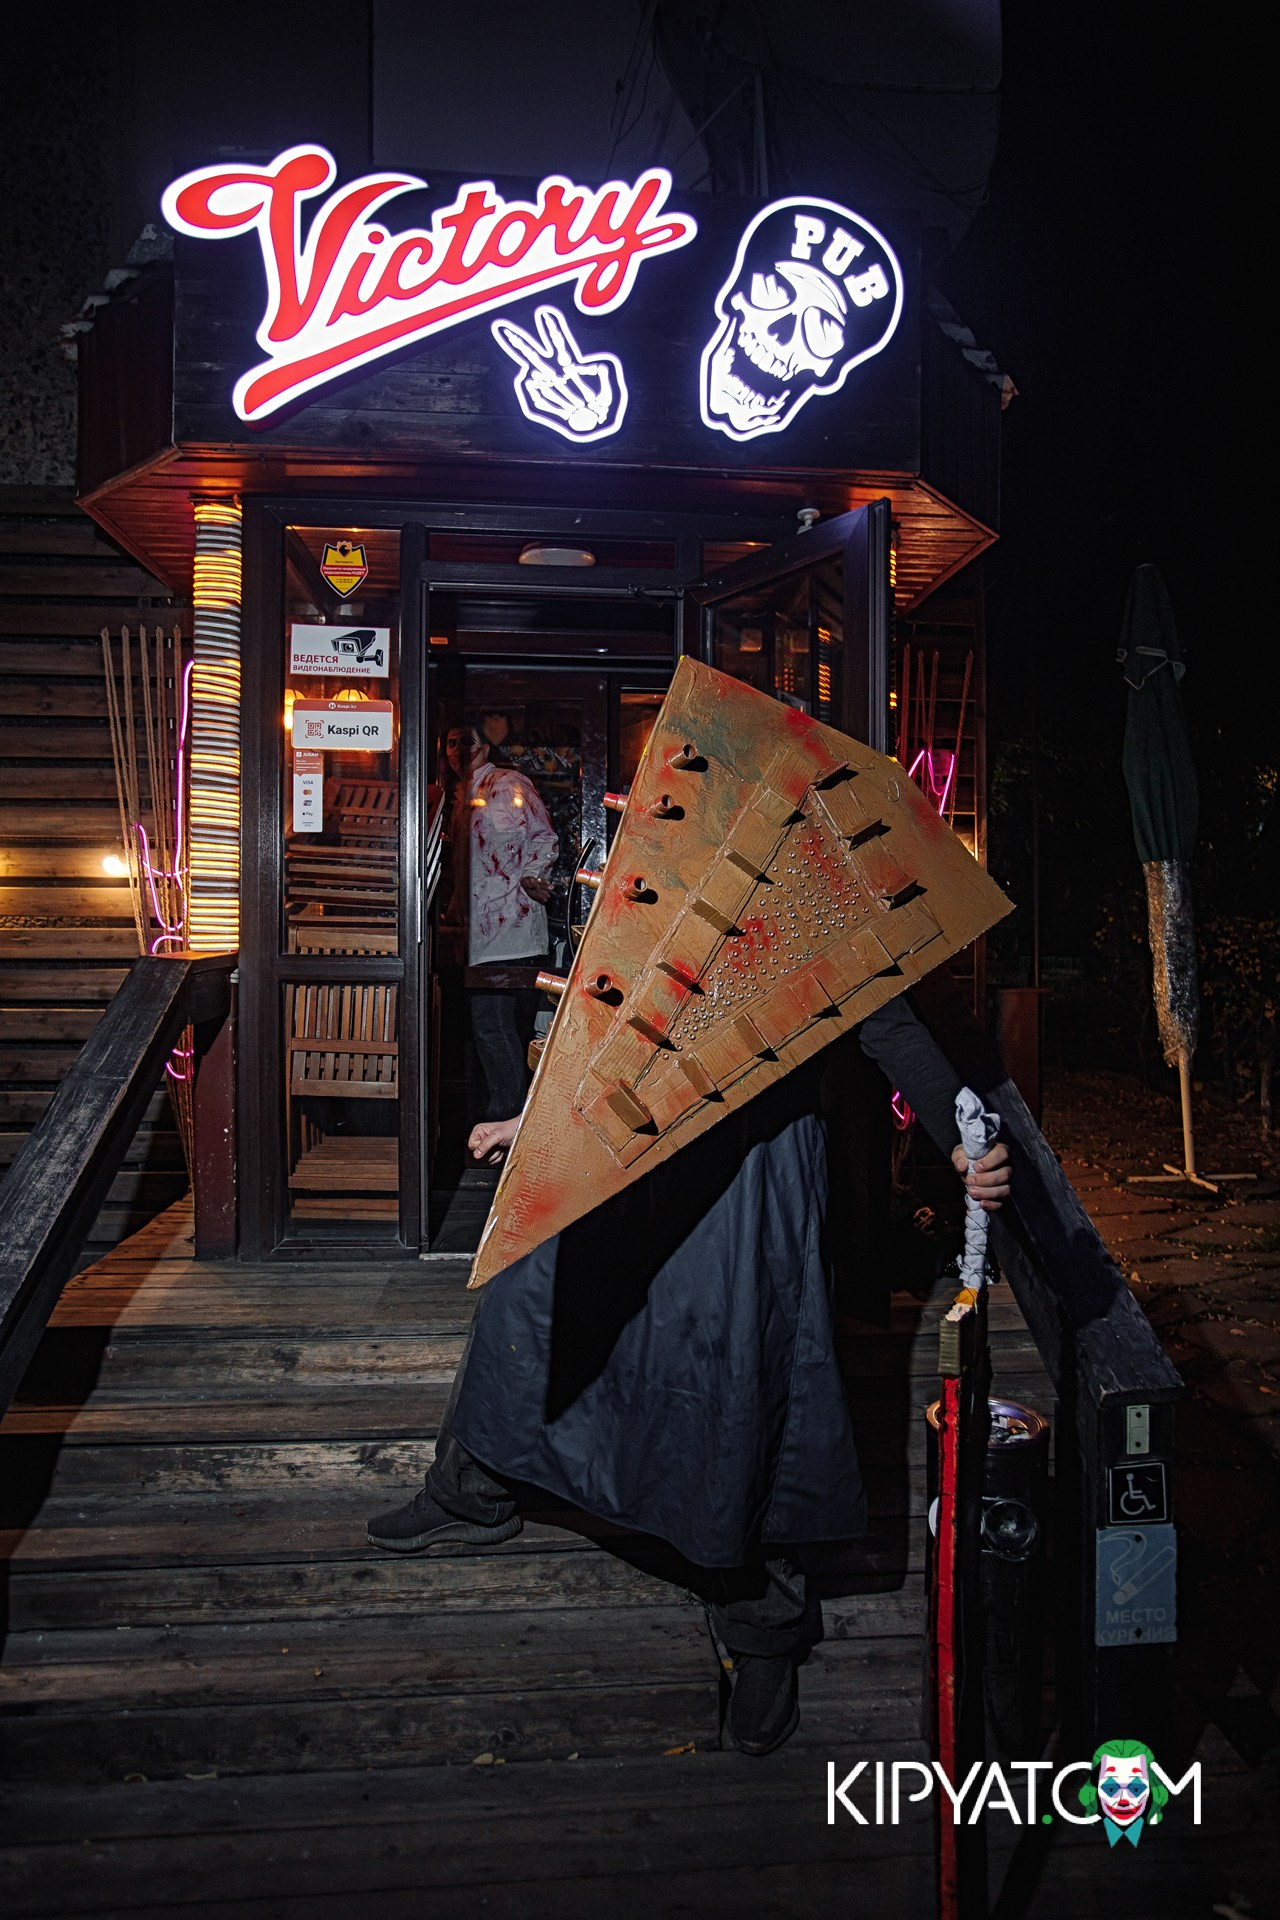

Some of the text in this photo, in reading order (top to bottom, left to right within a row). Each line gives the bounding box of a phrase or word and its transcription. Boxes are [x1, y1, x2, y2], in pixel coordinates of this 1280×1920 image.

[790, 213, 890, 308] PUB
[164, 145, 695, 417] Victory
[293, 653, 339, 664] ВЕДЕТСЯ
[293, 665, 371, 673] ВИДЕОНАБЛЮДЕНИЕ
[327, 725, 379, 738] Kaspi QR
[1105, 1607, 1167, 1624] МЕСТО
